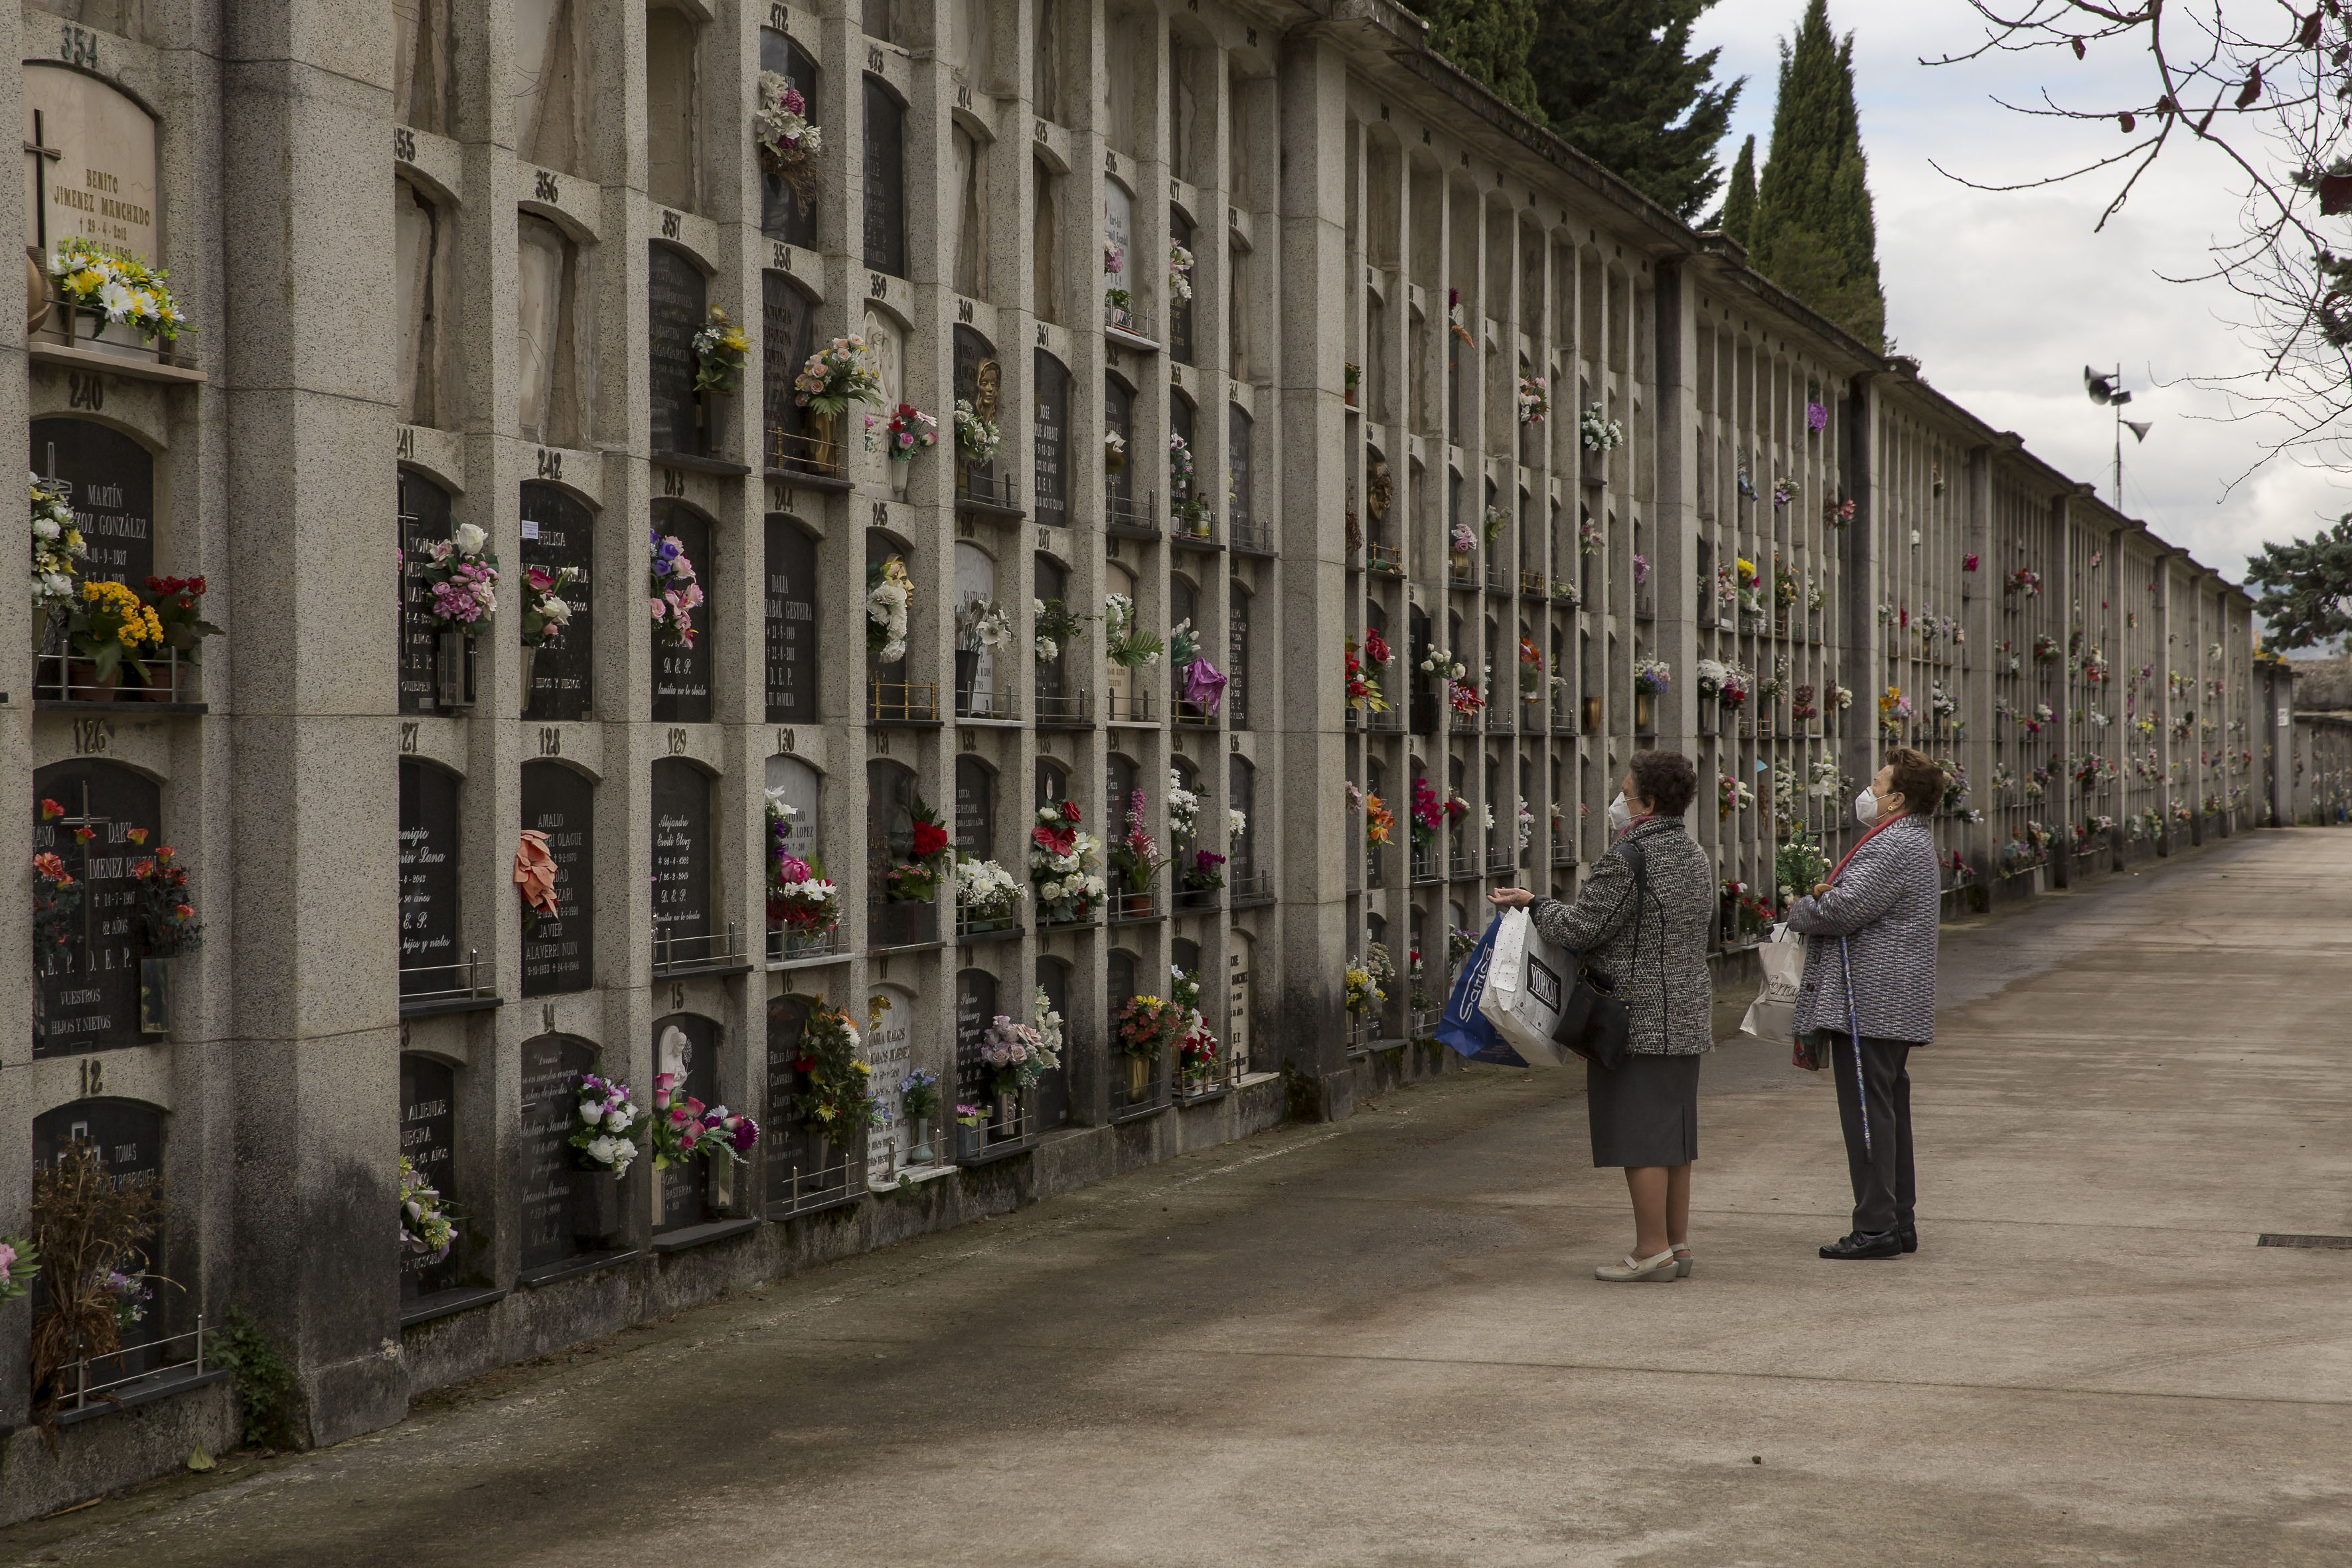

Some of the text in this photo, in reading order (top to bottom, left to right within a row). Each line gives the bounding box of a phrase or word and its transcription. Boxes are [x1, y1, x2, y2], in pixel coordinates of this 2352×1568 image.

[770, 3, 789, 31] 472
[61, 24, 98, 68] 354
[868, 44, 884, 73] 473
[394, 127, 416, 162] 55
[536, 169, 558, 203] 356
[101, 196, 150, 228] MANCHADO
[662, 209, 681, 240] 357
[773, 242, 791, 271] 358
[871, 274, 887, 299] 359
[959, 298, 973, 323] 360
[1037, 324, 1049, 347] 361
[69, 375, 104, 411] 240
[537, 448, 562, 479] 242
[88, 483, 123, 509] MARTÍN
[665, 468, 684, 498] 243
[775, 485, 794, 512] 244
[99, 512, 147, 540] GONZÁLEZ
[872, 503, 888, 526] 245
[771, 574, 789, 594] DALIA
[785, 600, 813, 622] GESTEIRA
[776, 692, 795, 707] FAMILIA
[74, 718, 106, 754] 126
[539, 727, 561, 755] 128
[667, 728, 686, 754] 129
[777, 728, 795, 752] 130
[876, 733, 890, 755] 131
[962, 730, 977, 751] 132
[538, 813, 564, 828] AMALIO
[797, 826, 814, 838] LOPEZ
[558, 832, 583, 848] OLAGUE
[538, 922, 563, 939] JAVIER
[562, 941, 578, 956] NUIN
[880, 957, 888, 979] 17
[781, 970, 793, 994] 16
[1530, 965, 1559, 1008] YORKAL
[60, 988, 101, 1006] VUESTROS
[671, 982, 684, 1010] 15
[51, 1019, 74, 1036] HIJOS
[82, 1014, 112, 1032] NIETOS
[543, 1003, 555, 1032] 14
[401, 1018, 410, 1047] 3
[79, 1058, 103, 1094] 12
[115, 1142, 137, 1164] TOMAS
